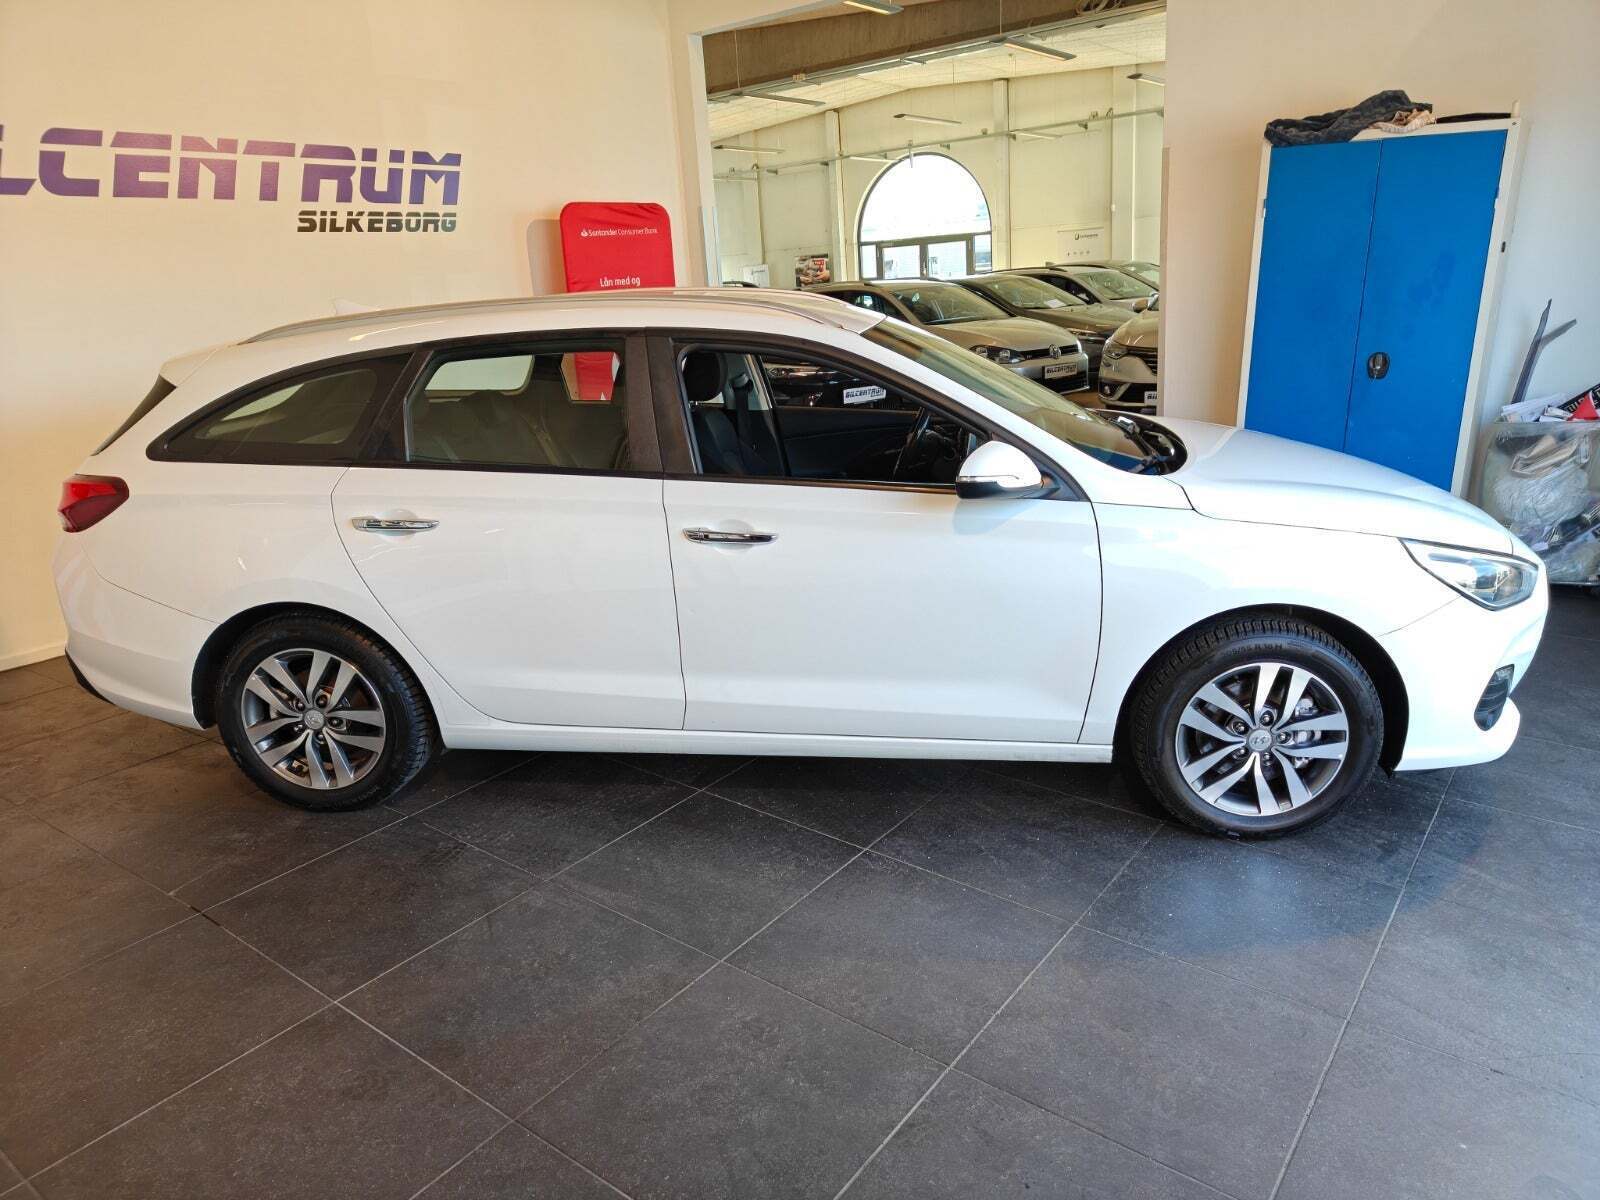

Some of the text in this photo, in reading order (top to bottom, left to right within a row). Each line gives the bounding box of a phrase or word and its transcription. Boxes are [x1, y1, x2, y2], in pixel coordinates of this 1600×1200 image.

[297, 210, 457, 232] SILKEBORG
[588, 229, 617, 237] Santander
[600, 276, 640, 287] Lån med og
